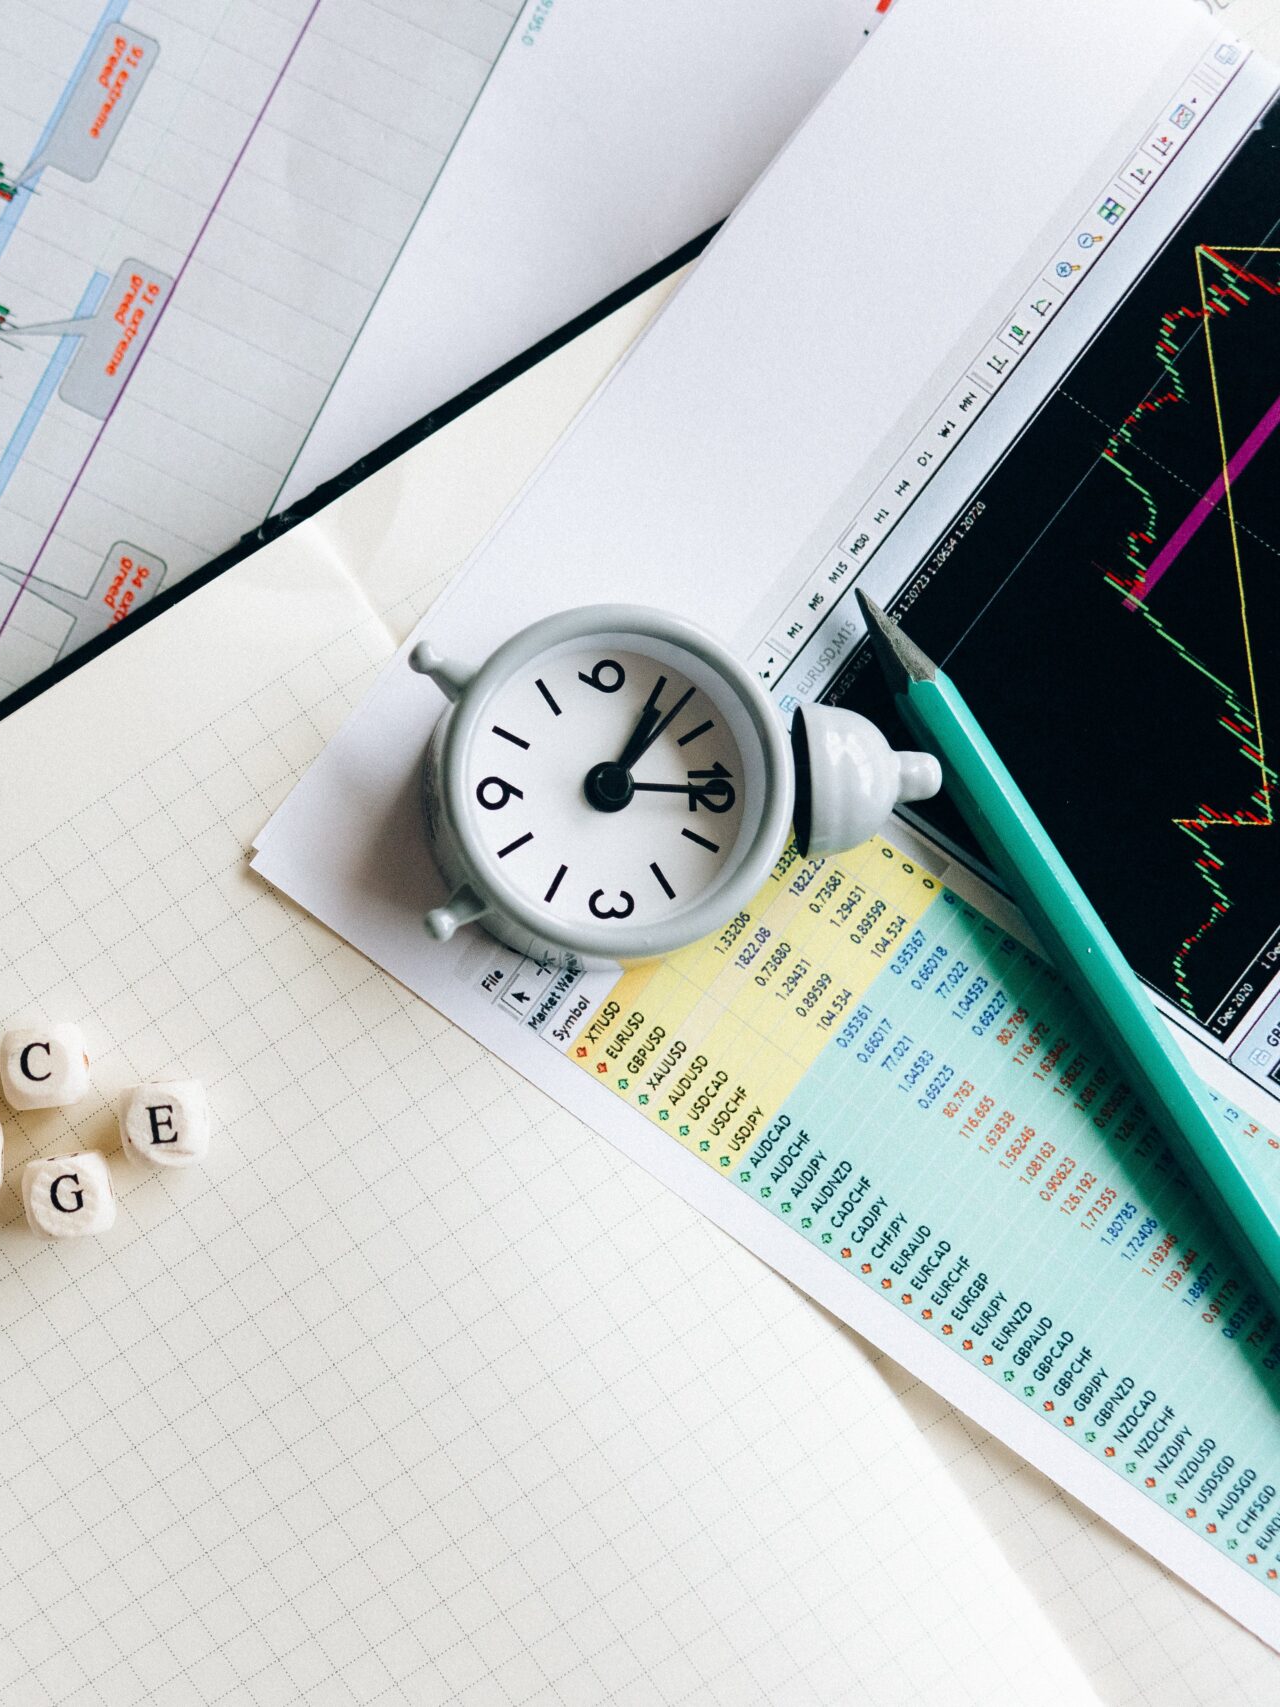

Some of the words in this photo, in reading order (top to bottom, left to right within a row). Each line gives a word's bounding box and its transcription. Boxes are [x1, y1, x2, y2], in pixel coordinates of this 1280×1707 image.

[94, 35, 131, 88] greed
[124, 44, 144, 68] 91
[87, 68, 132, 140] extreme
[111, 273, 146, 325] greed
[140, 280, 161, 305] 91
[103, 306, 148, 378] extreme
[787, 621, 803, 639] M1
[828, 561, 849, 584] M15
[849, 532, 871, 556] M30
[873, 506, 890, 524] H1
[894, 478, 911, 497] H4
[916, 449, 933, 467] D1
[958, 390, 977, 412] MN
[99, 555, 137, 610] greed
[130, 565, 150, 589] 94
[898, 574, 930, 612] 1.20723
[926, 536, 958, 575] 1.20654
[954, 500, 986, 538] 1.20720
[577, 658, 625, 693] 9
[795, 619, 859, 697] EURUSD,M15
[476, 776, 524, 811] 6
[687, 761, 735, 813] 12
[588, 888, 634, 919] 3
[480, 966, 503, 992] File
[625, 1024, 667, 1075] GBPUSD
[713, 910, 752, 956] 1.33206
[666, 1053, 709, 1106] AUDUSD
[754, 941, 793, 987] 0.73680
[808, 869, 846, 914] 0.73681
[687, 1069, 729, 1121] USDCAD
[775, 957, 812, 1001] 1.29431
[829, 884, 866, 929] 1.29431
[1216, 1005, 1236, 1027] Dec
[1231, 981, 1254, 1008] 2020
[526, 990, 561, 1030] Market
[551, 994, 593, 1043] Symbol
[584, 999, 621, 1045] XTIUSD
[605, 1010, 646, 1060] EURUSD
[646, 1039, 688, 1091] XAUUSD
[734, 925, 772, 971] 1822.08
[707, 1085, 749, 1136] USDCHF
[794, 971, 833, 1018] 0.89599
[849, 898, 887, 945] 0.89599
[727, 1105, 767, 1152] USDJPY
[816, 987, 854, 1032] 104.534
[870, 914, 908, 960] 104.534
[20, 1042, 52, 1082] C
[747, 1113, 792, 1168] AUDCAD
[835, 1003, 873, 1049] 0.95361
[890, 929, 928, 975] 0.95367
[767, 1129, 812, 1183] AUDCHF
[856, 1018, 894, 1064] 0.66017
[910, 944, 949, 991] 0.66018
[788, 1149, 829, 1199] AUDJPY
[881, 1034, 915, 1073] 77.021
[935, 960, 970, 1000] 77.022
[808, 1159, 853, 1214] AUDNZD
[951, 975, 989, 1021] 1.04593
[829, 1175, 873, 1229] CADCHF
[917, 1064, 955, 1110] 0.69225
[971, 990, 1010, 1037] 0.69227
[50, 1173, 85, 1213] G
[146, 1105, 178, 1144] E
[849, 1196, 890, 1245] CADJPY
[942, 1079, 976, 1119] 80.763
[910, 1239, 952, 1290] EURCAD
[998, 1125, 1037, 1171] 1.56246
[870, 1212, 910, 1260] CHFJPY
[890, 1224, 933, 1276] EURAUD
[950, 1272, 991, 1322] EURGBP
[1038, 1156, 1077, 1203] 0.90623
[971, 1291, 1009, 1337] EURJPY
[1059, 1171, 1098, 1217] 126.192
[930, 1255, 972, 1306] EURCHF
[991, 1300, 1034, 1352] EURNZD
[1080, 1187, 1118, 1232] 1.71355
[1012, 1316, 1054, 1367] GBPAUD
[1100, 1202, 1138, 1247] 1.80785
[1032, 1330, 1075, 1382] GBPCAD
[1120, 1216, 1159, 1263] 1.72406
[1052, 1346, 1095, 1398] GBPCHF
[1141, 1231, 1179, 1278] 1.19346
[1093, 1375, 1137, 1428] GBPNZD
[1182, 1262, 1220, 1309] 1.89077
[1072, 1367, 1111, 1413] GBPJPY
[1113, 1389, 1158, 1444] NZDCAD
[1134, 1405, 1178, 1459] NZDCHF
[1153, 1425, 1194, 1474] NZDJPY
[1174, 1436, 1217, 1489] NZDUSD
[1194, 1454, 1235, 1504] USDSGD
[1214, 1467, 1258, 1520] AUDSGD
[1234, 1483, 1278, 1536] CHFSGD
[1254, 1513, 1280, 1551] EURD
